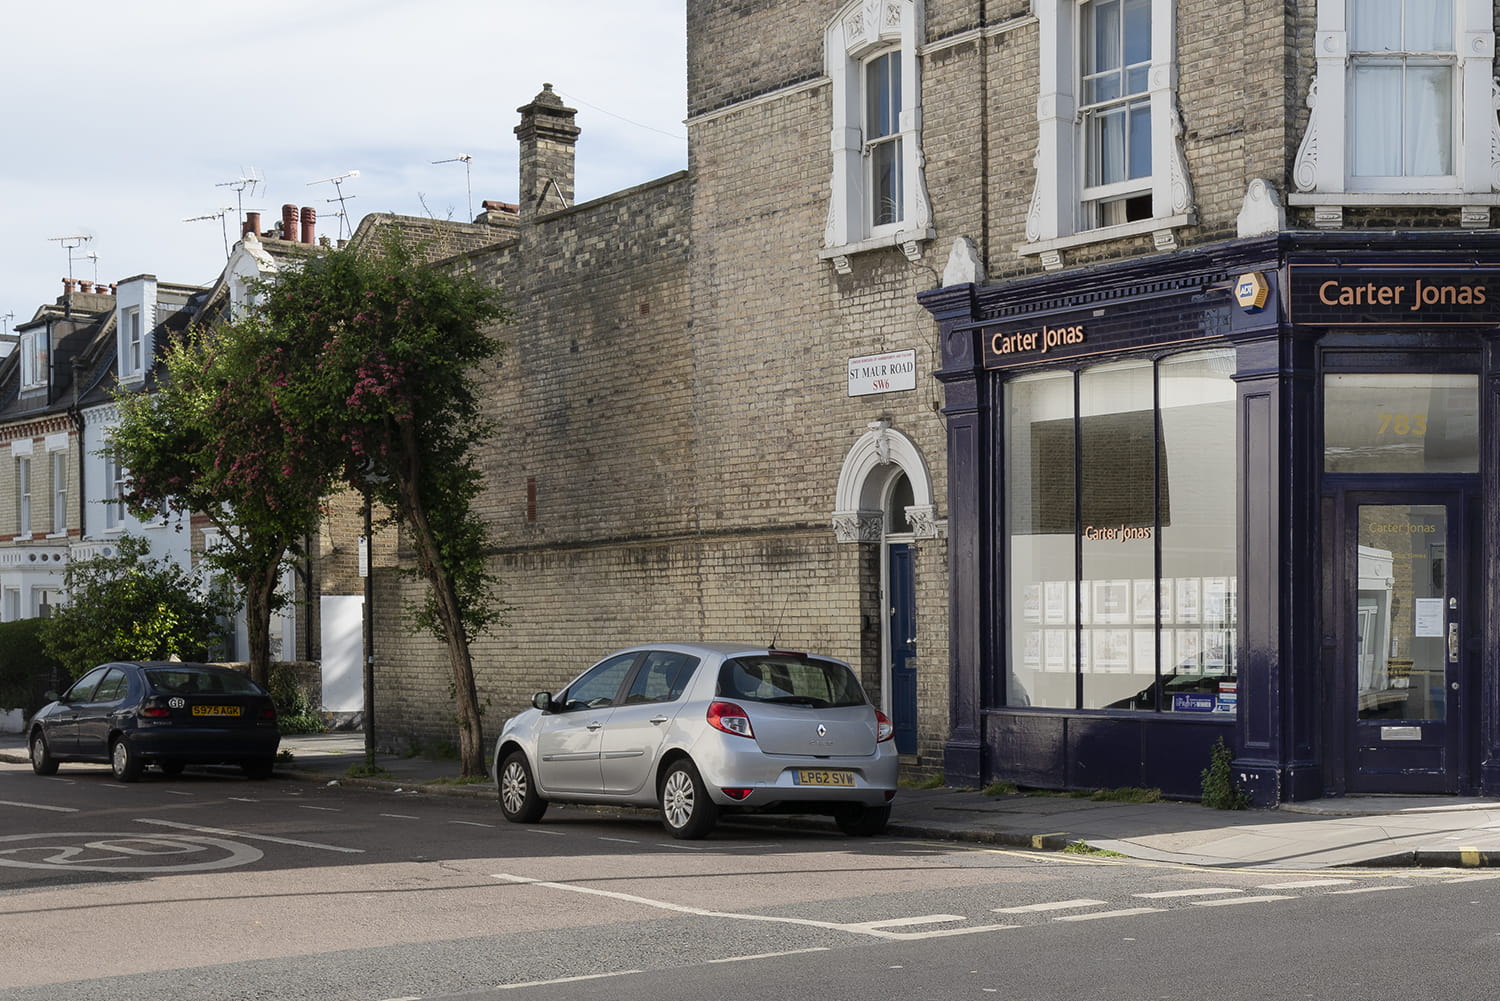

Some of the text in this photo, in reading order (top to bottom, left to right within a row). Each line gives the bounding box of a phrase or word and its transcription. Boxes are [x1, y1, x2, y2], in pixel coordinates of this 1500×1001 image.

[1319, 279, 1487, 311] Carter Jonas
[991, 325, 1084, 355] Carter Jonas
[850, 362, 913, 379] ST MAUR ROAD
[872, 379, 890, 390] SW6
[1376, 414, 1427, 435] 783
[1085, 524, 1151, 543] Carter Jonas
[1368, 522, 1436, 535] Carter Jonas
[170, 698, 184, 708] GB
[194, 706, 238, 716] S975 AGK
[800, 772, 854, 785] LP62 SVW
